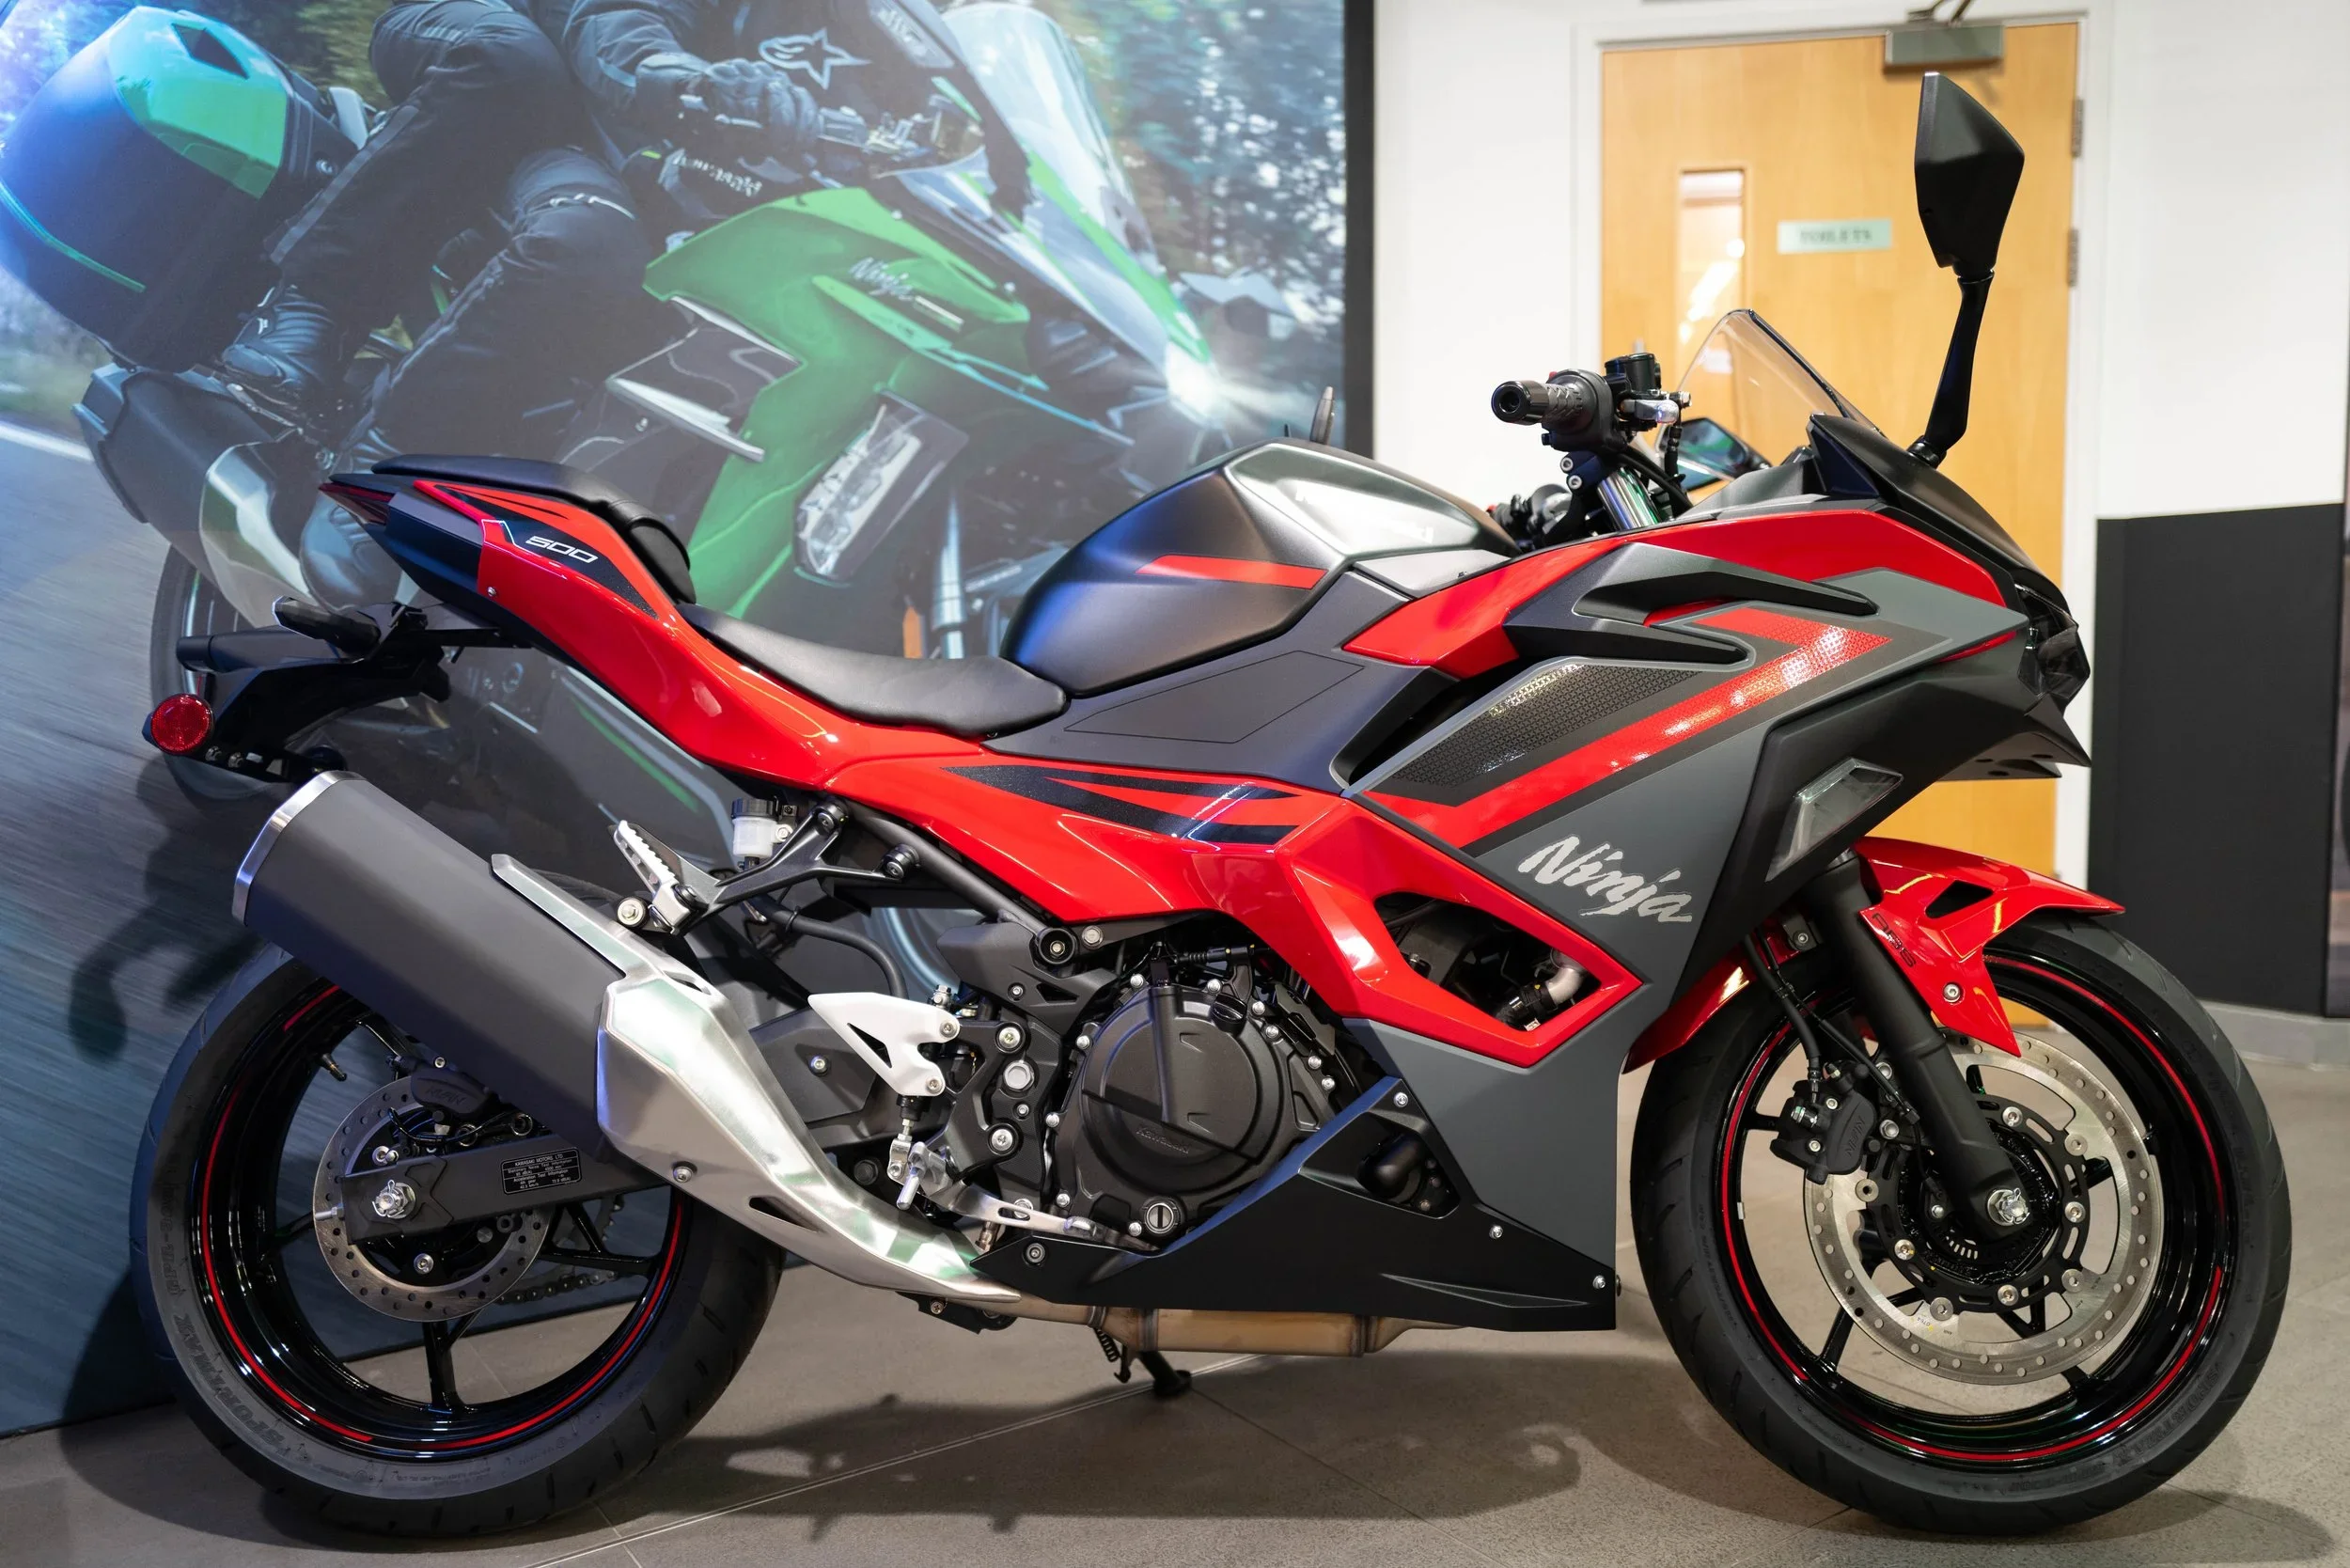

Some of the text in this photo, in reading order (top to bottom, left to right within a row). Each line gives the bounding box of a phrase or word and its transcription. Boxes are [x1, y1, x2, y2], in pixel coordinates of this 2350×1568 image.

[1799, 228, 1872, 245] TOILETS
[525, 535, 599, 563] 500
[1517, 835, 1693, 923] Ninja
[1872, 913, 1917, 967] ABS
[173, 1314, 285, 1448] SPORTMAX
[2116, 1365, 2219, 1466] SPORTMAX
